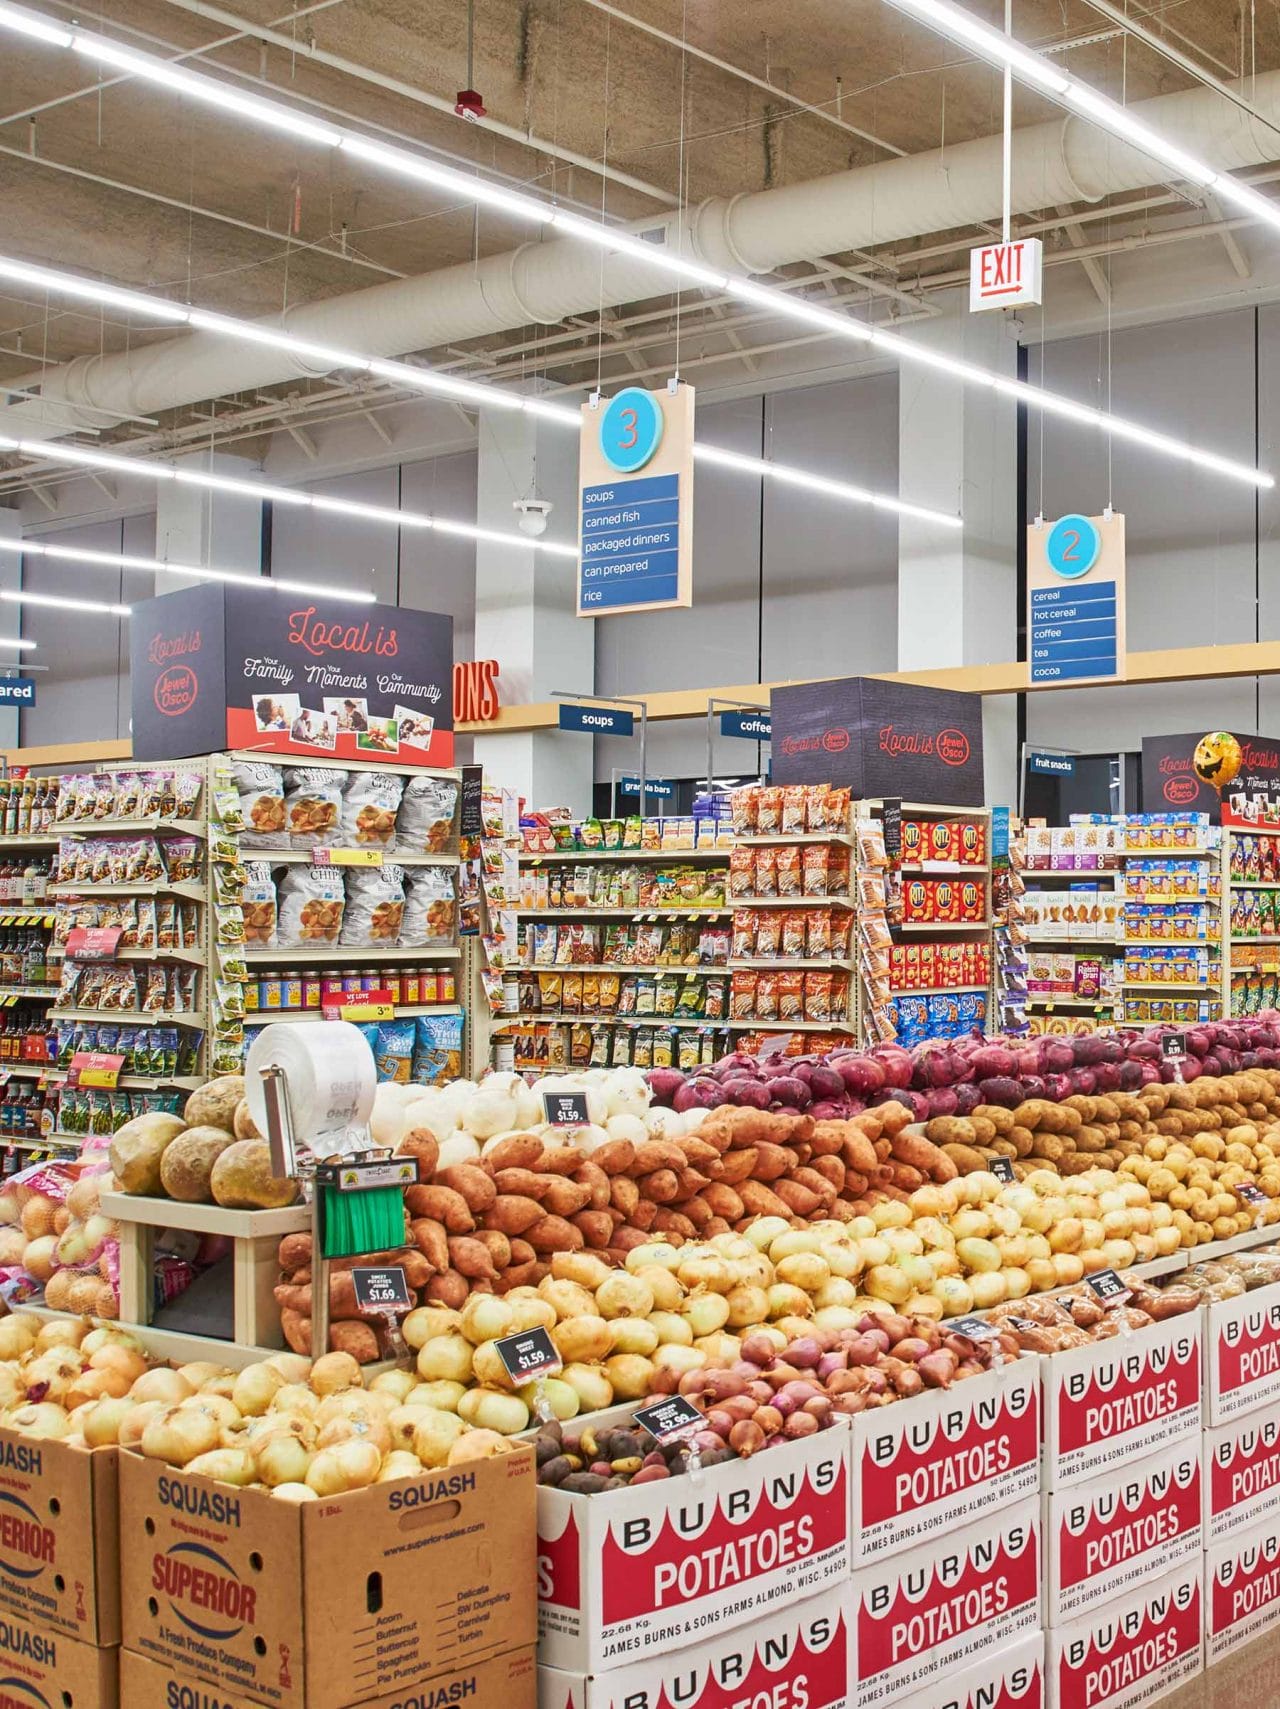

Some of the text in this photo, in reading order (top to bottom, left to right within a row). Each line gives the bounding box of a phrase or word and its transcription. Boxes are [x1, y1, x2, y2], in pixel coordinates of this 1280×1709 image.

[981, 244, 1024, 288] EXIT
[618, 408, 638, 449] 3
[585, 489, 614, 503] soups
[585, 511, 640, 528] canned fish
[585, 532, 670, 553] packaged dinners
[1063, 530, 1081, 561] 2
[584, 560, 648, 577] can prepared
[584, 589, 602, 602] rice
[1034, 592, 1060, 601] cereal
[1034, 608, 1076, 619] hot cereal
[288, 607, 398, 657] Local is
[1034, 629, 1061, 639] coffee
[148, 634, 184, 664] Local
[1034, 649, 1048, 658] tea
[264, 657, 278, 665] Your
[327, 665, 341, 673] Your
[244, 657, 293, 685] Family
[305, 665, 367, 690] Moments
[1034, 667, 1060, 676] cocoa
[0, 685, 31, 698] ared
[161, 674, 189, 694] Jewel
[377, 674, 441, 703] Community
[582, 714, 613, 727] soups
[740, 719, 771, 733] coffee
[879, 725, 934, 757] Local is
[941, 735, 964, 748] Jewel
[942, 746, 963, 759] Osco
[1035, 757, 1072, 771] fruit snacks
[1159, 756, 1191, 774] Local
[654, 784, 671, 794] bars
[1168, 781, 1192, 791] Jewel
[906, 828, 919, 844] RITZ
[935, 828, 949, 845] RITZ
[963, 830, 977, 845] RITZ
[911, 889, 924, 904] RITZ
[937, 889, 951, 904] RITZ
[964, 890, 977, 904] RITZ
[1078, 965, 1098, 974] Raisin
[558, 1110, 578, 1121] $1.59
[369, 1289, 395, 1301] $1.69
[519, 1350, 545, 1369] $1.59
[1070, 1338, 1189, 1396] BURNS
[1086, 1379, 1177, 1442] POTATOES
[660, 1413, 689, 1431] $2.99
[876, 1387, 1025, 1461] BURNS
[507, 1457, 531, 1467] Produce
[896, 1435, 1010, 1512] POTATOES
[388, 1472, 476, 1511] SQUASH
[1070, 1460, 1191, 1530] BURNS
[158, 1476, 240, 1528] SQUASH
[623, 1460, 834, 1549] BURNS
[862, 1538, 888, 1555] JAMES
[890, 1526, 915, 1544] BURNS
[923, 1515, 943, 1529] SONS
[944, 1505, 967, 1522] FARMS
[969, 1492, 998, 1511] ALMOND,
[999, 1485, 1017, 1498] WISC.
[1018, 1474, 1037, 1490] 54909
[0, 1514, 56, 1564] ERIOR
[383, 1522, 485, 1557] www.superior-sales.com
[1086, 1503, 1179, 1575] POTATOES
[654, 1515, 814, 1607] POTATOES
[786, 1545, 846, 1576] 50 LBS. MINIMUM
[871, 1527, 1023, 1613] BURNS
[152, 1553, 257, 1625] SUPERIOR
[457, 1592, 511, 1615] SW Dumpling
[602, 1558, 847, 1658] JAMES BURNS & SONS FARMS ALMOND, WISC. 54909
[376, 1612, 403, 1626] Acorn
[457, 1612, 490, 1629] Carnival
[892, 1576, 1008, 1663] POTATOES
[1070, 1583, 1190, 1665] BURNS
[376, 1622, 417, 1641] Butternut
[458, 1629, 483, 1643] Turbin
[601, 1620, 651, 1639] 22.68 Kg.
[159, 1626, 256, 1677] A Fresh Produce Company
[376, 1636, 420, 1655] Buttercup
[377, 1651, 418, 1670] Spaghetti
[624, 1618, 830, 1709] BURNS
[1086, 1626, 1178, 1707] POTATOES
[377, 1661, 431, 1684] Pie Pumpkin
[390, 1677, 476, 1709] QUASH
